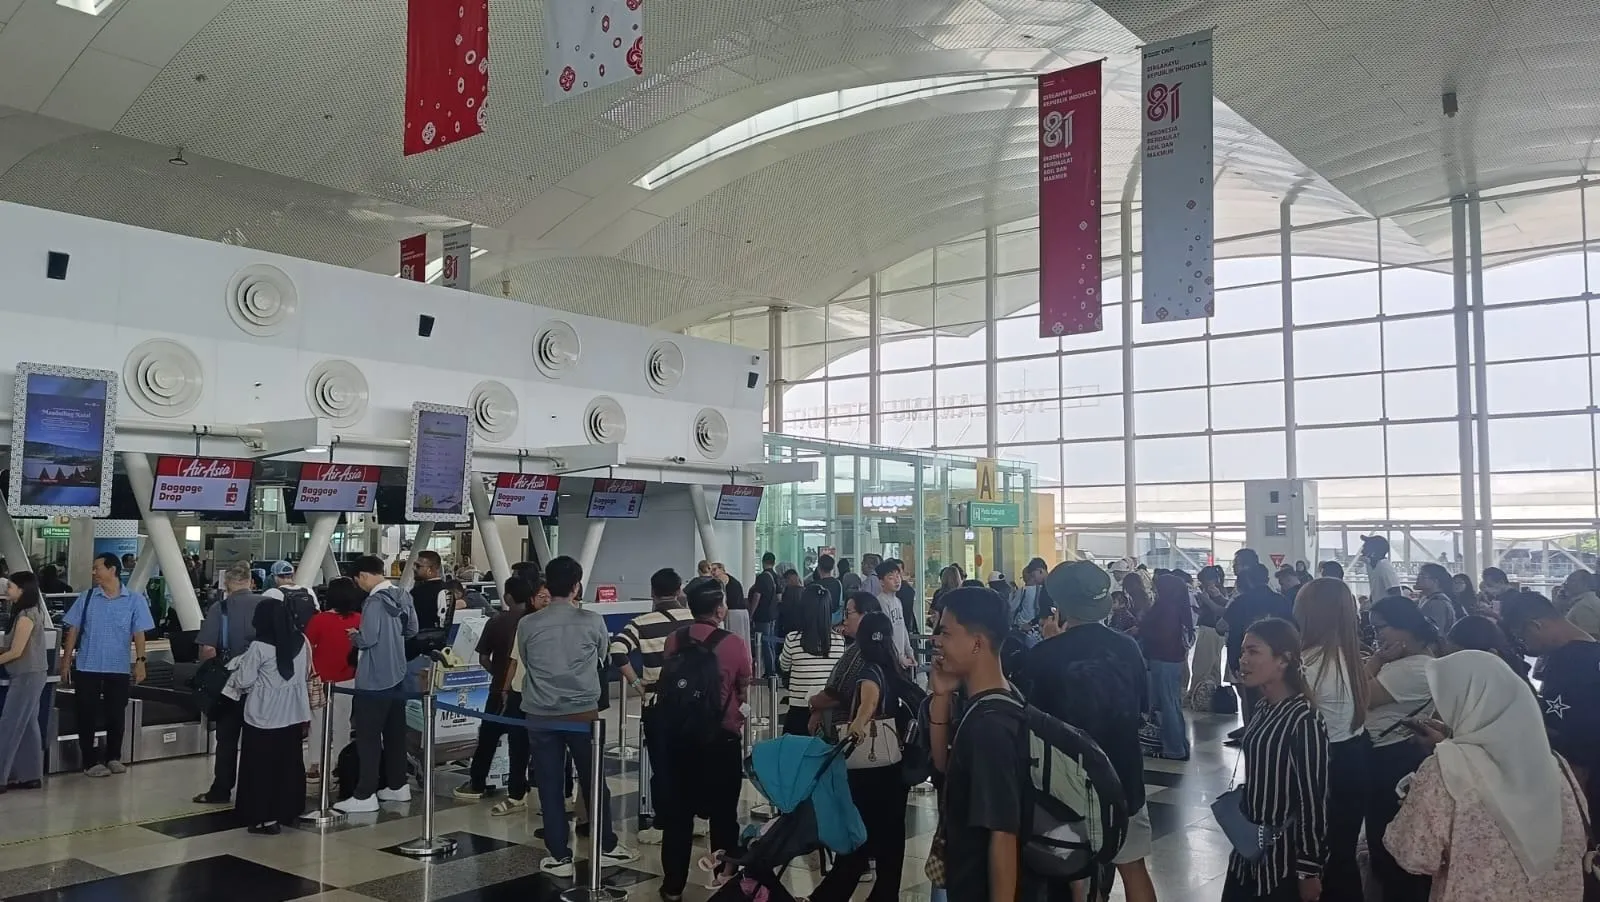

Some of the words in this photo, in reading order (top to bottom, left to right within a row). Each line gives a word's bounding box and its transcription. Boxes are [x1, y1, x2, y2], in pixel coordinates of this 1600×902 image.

[1147, 60, 1179, 72] DIRGAHAYU
[1147, 67, 1174, 79] REPUBLIK
[1175, 60, 1207, 72] INDONESIA
[1043, 89, 1072, 101] DIRGAHAYU
[1043, 97, 1068, 107] REPUBLIK
[1069, 89, 1096, 100] INDONESIA
[1146, 81, 1183, 123] 81
[1043, 109, 1076, 149] 81
[1147, 125, 1178, 136] INDONESIA
[1147, 132, 1180, 144] BERDAULAT
[1161, 141, 1174, 149] DAN
[1043, 151, 1071, 162] INDONESIA
[1147, 148, 1174, 158] MAKMUR
[1043, 157, 1073, 168] BERDAULAT
[1043, 172, 1068, 182] MAKMUR
[444, 255, 459, 280] 81
[160, 482, 203, 494] Baggage
[980, 465, 992, 500] A
[302, 486, 338, 496] Baggage
[159, 492, 182, 502] Drop
[300, 495, 320, 503] Drop
[497, 493, 526, 502] Baggage
